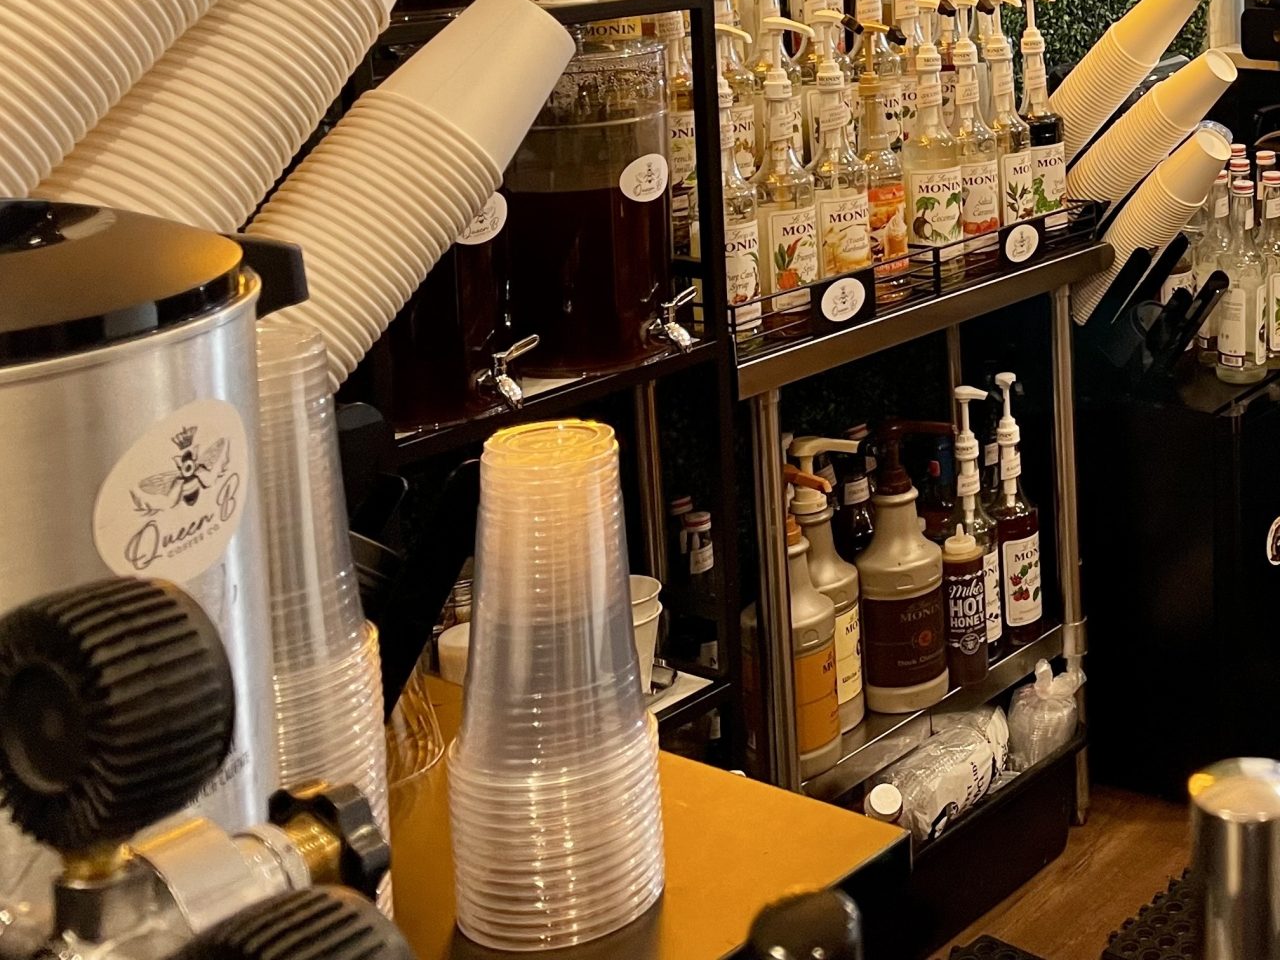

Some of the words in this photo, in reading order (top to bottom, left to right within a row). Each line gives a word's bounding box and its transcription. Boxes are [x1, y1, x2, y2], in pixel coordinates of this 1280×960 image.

[124, 513, 214, 570] Queen
[216, 473, 240, 522] B
[949, 593, 984, 617] HOT
[950, 610, 985, 628] HONEY
